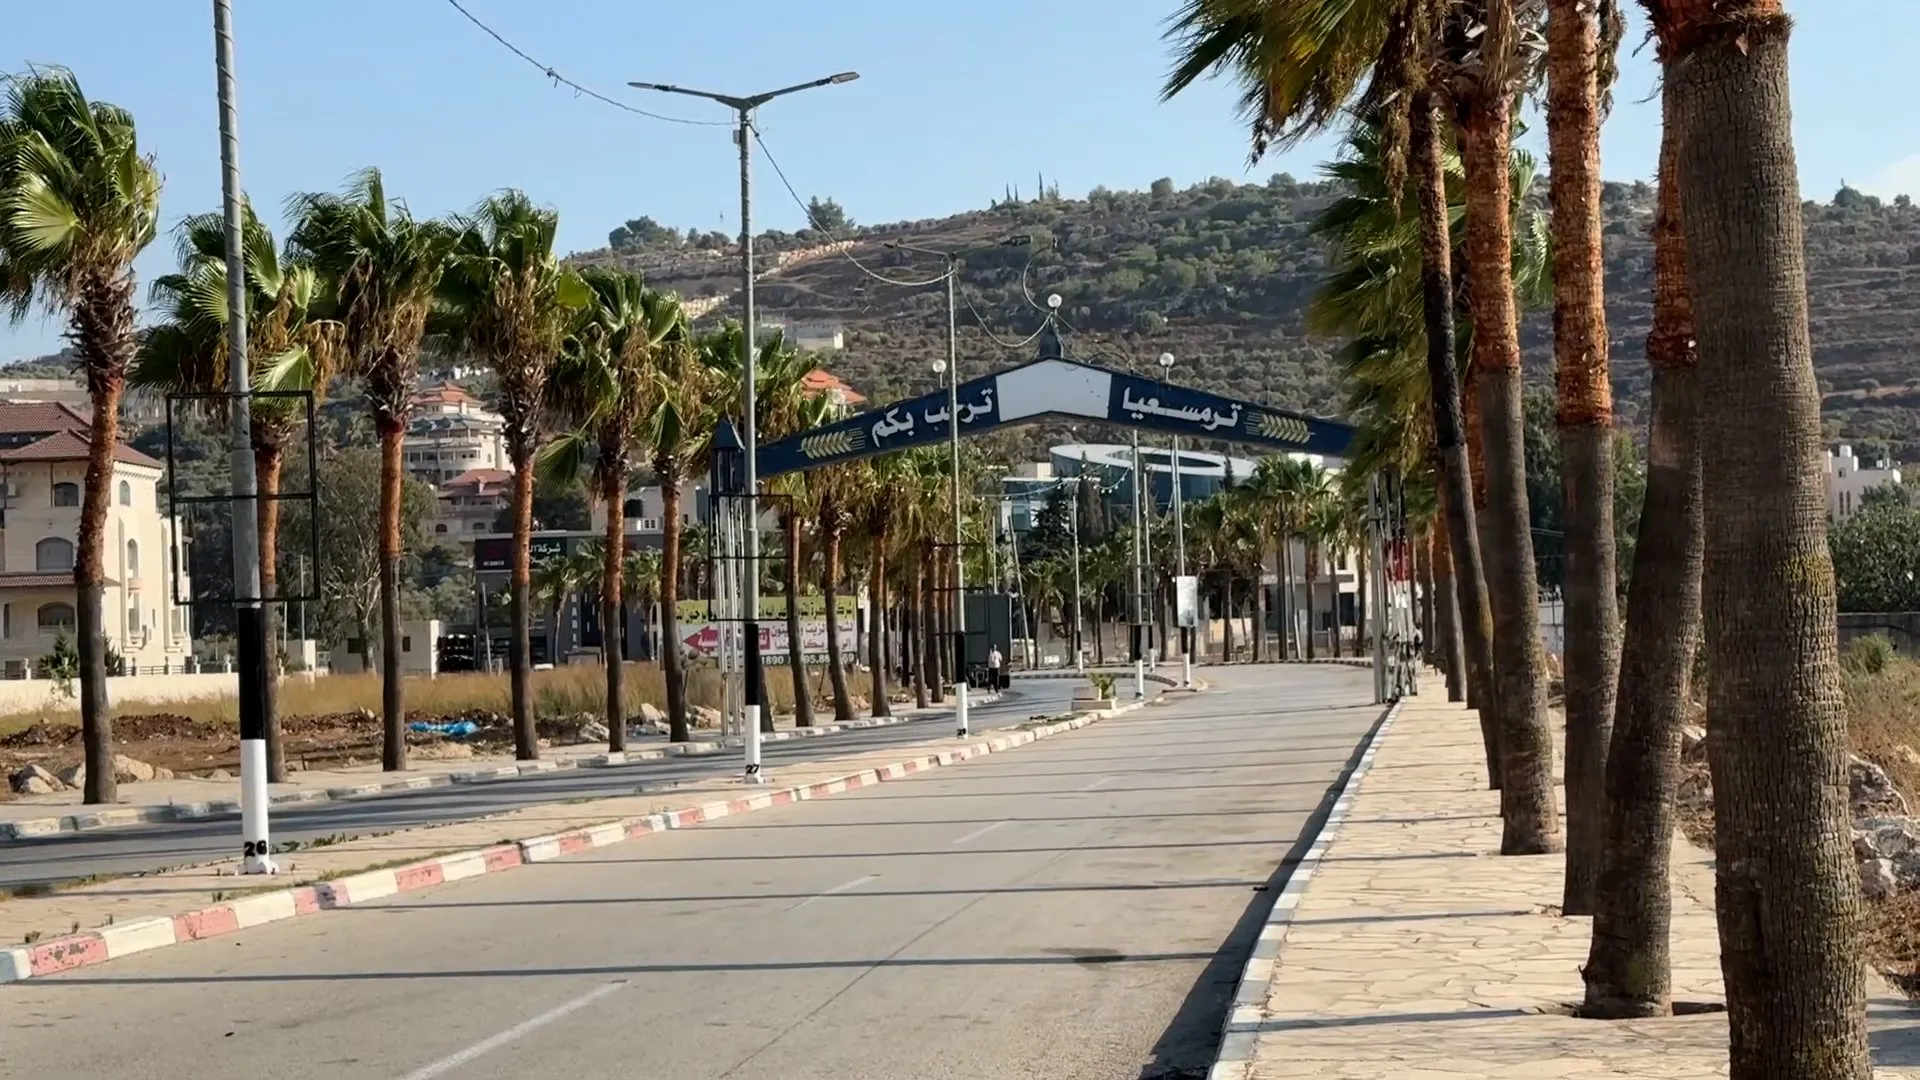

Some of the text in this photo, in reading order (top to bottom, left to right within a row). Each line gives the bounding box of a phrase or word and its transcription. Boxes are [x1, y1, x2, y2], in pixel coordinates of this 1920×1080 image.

[871, 406, 914, 448] بكم
[1122, 387, 1243, 431] ترمسعيا
[745, 763, 760, 775] 27
